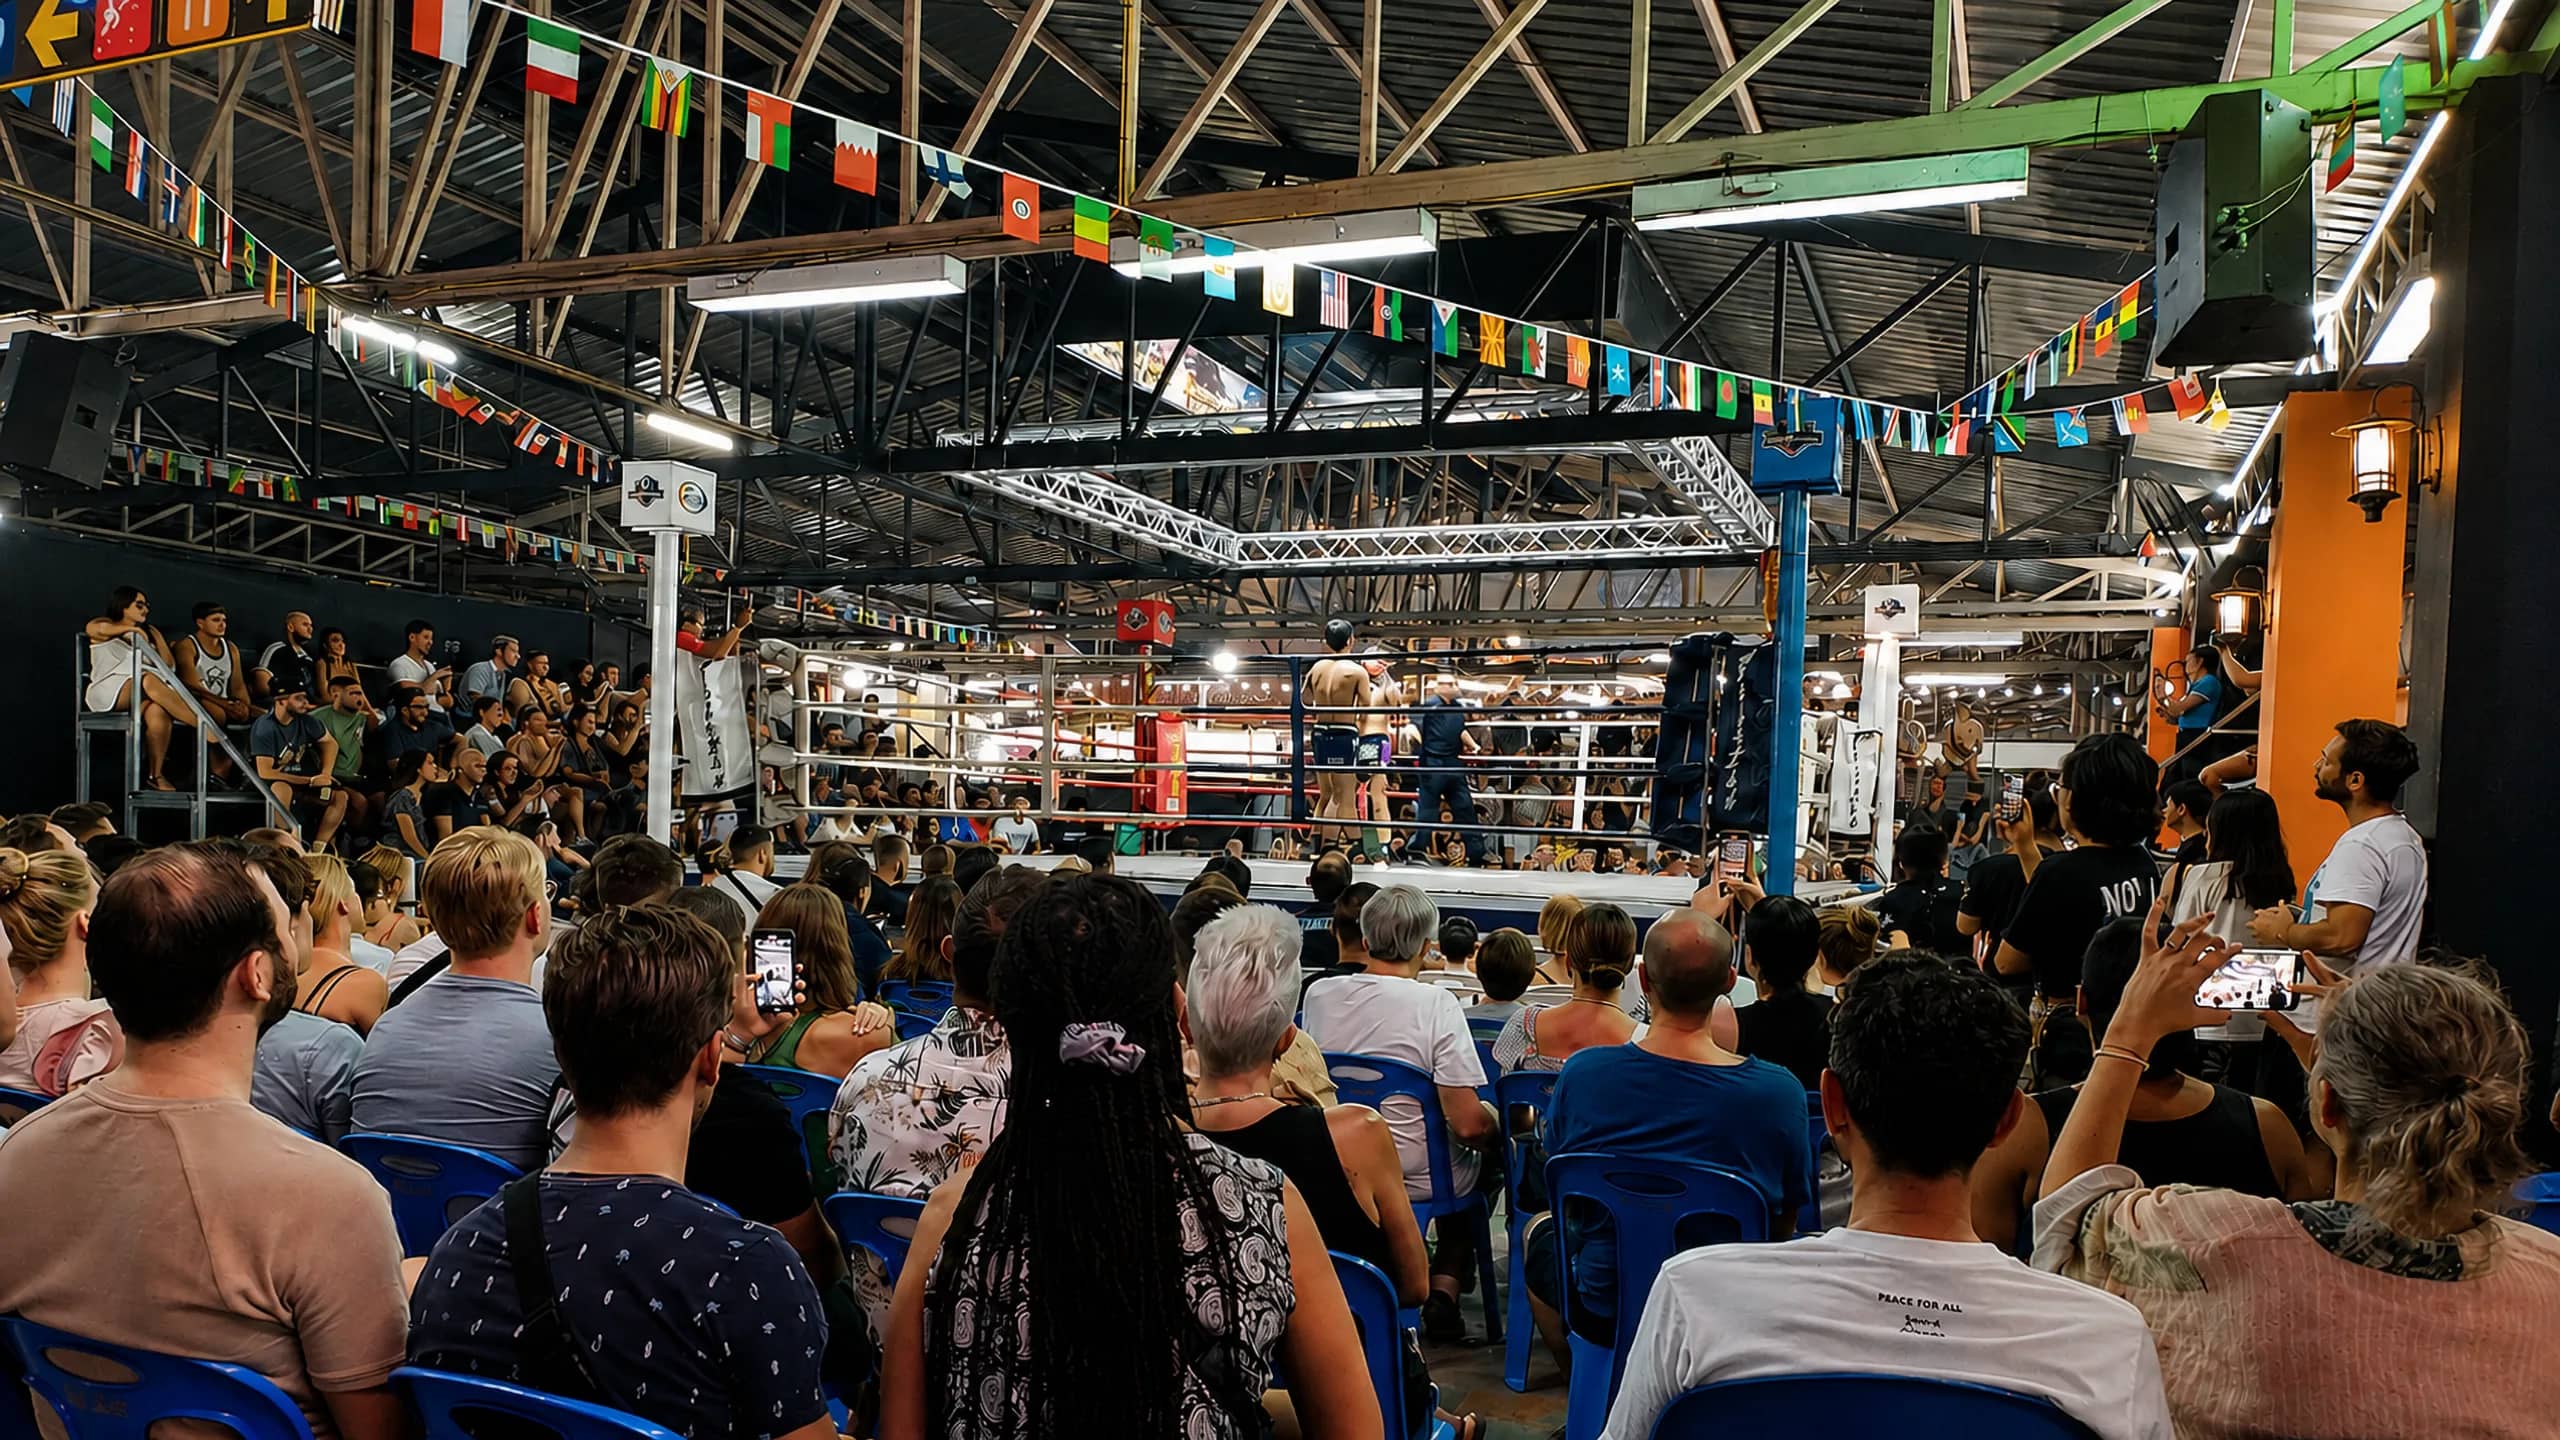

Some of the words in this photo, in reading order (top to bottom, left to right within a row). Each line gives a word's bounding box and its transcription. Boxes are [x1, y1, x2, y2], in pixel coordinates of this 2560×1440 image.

[1878, 1292, 1913, 1306] PEACE
[1917, 1299, 1940, 1310] FOR
[1942, 1303, 1963, 1313] ALL
